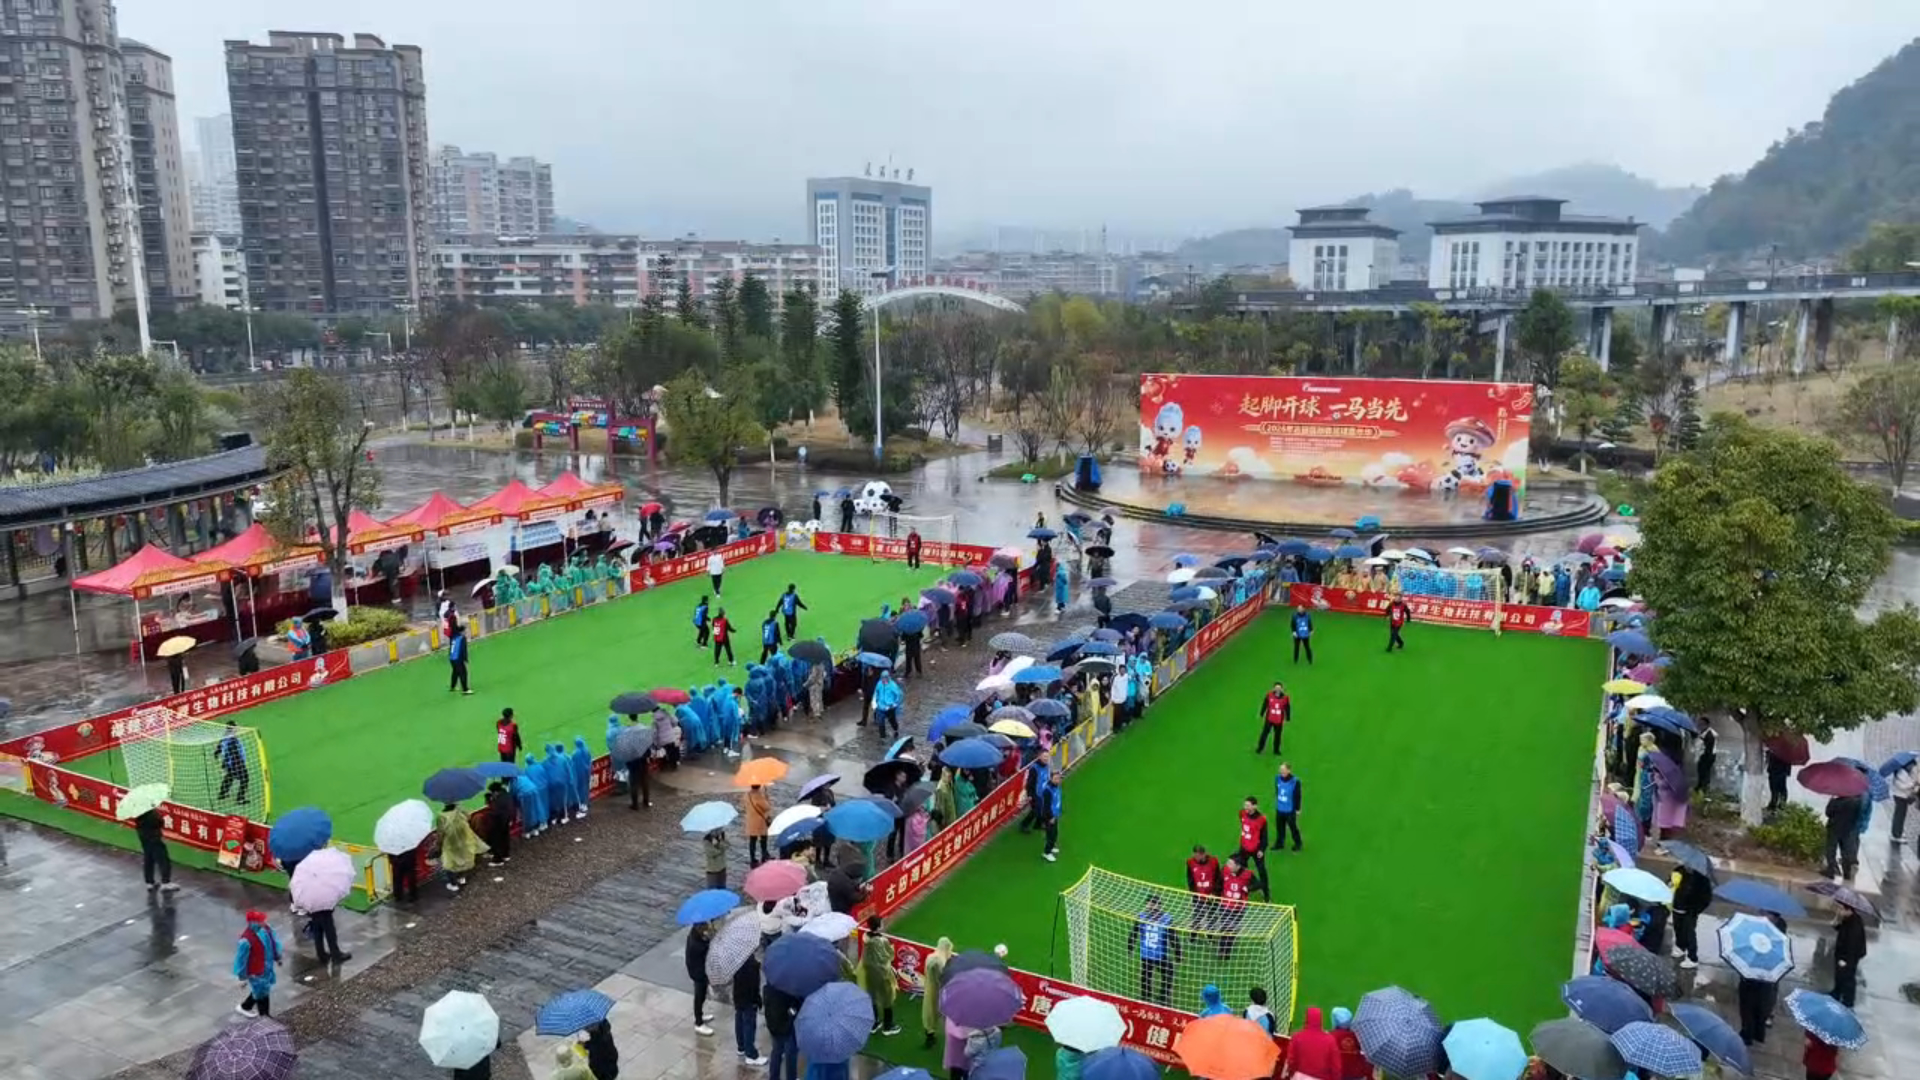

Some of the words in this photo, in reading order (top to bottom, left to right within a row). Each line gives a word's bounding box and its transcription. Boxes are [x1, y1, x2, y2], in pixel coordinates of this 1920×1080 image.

[1238, 393, 1321, 419] 起脚开球
[1328, 397, 1408, 422] 一马当先
[1146, 932, 1158, 948] 12
